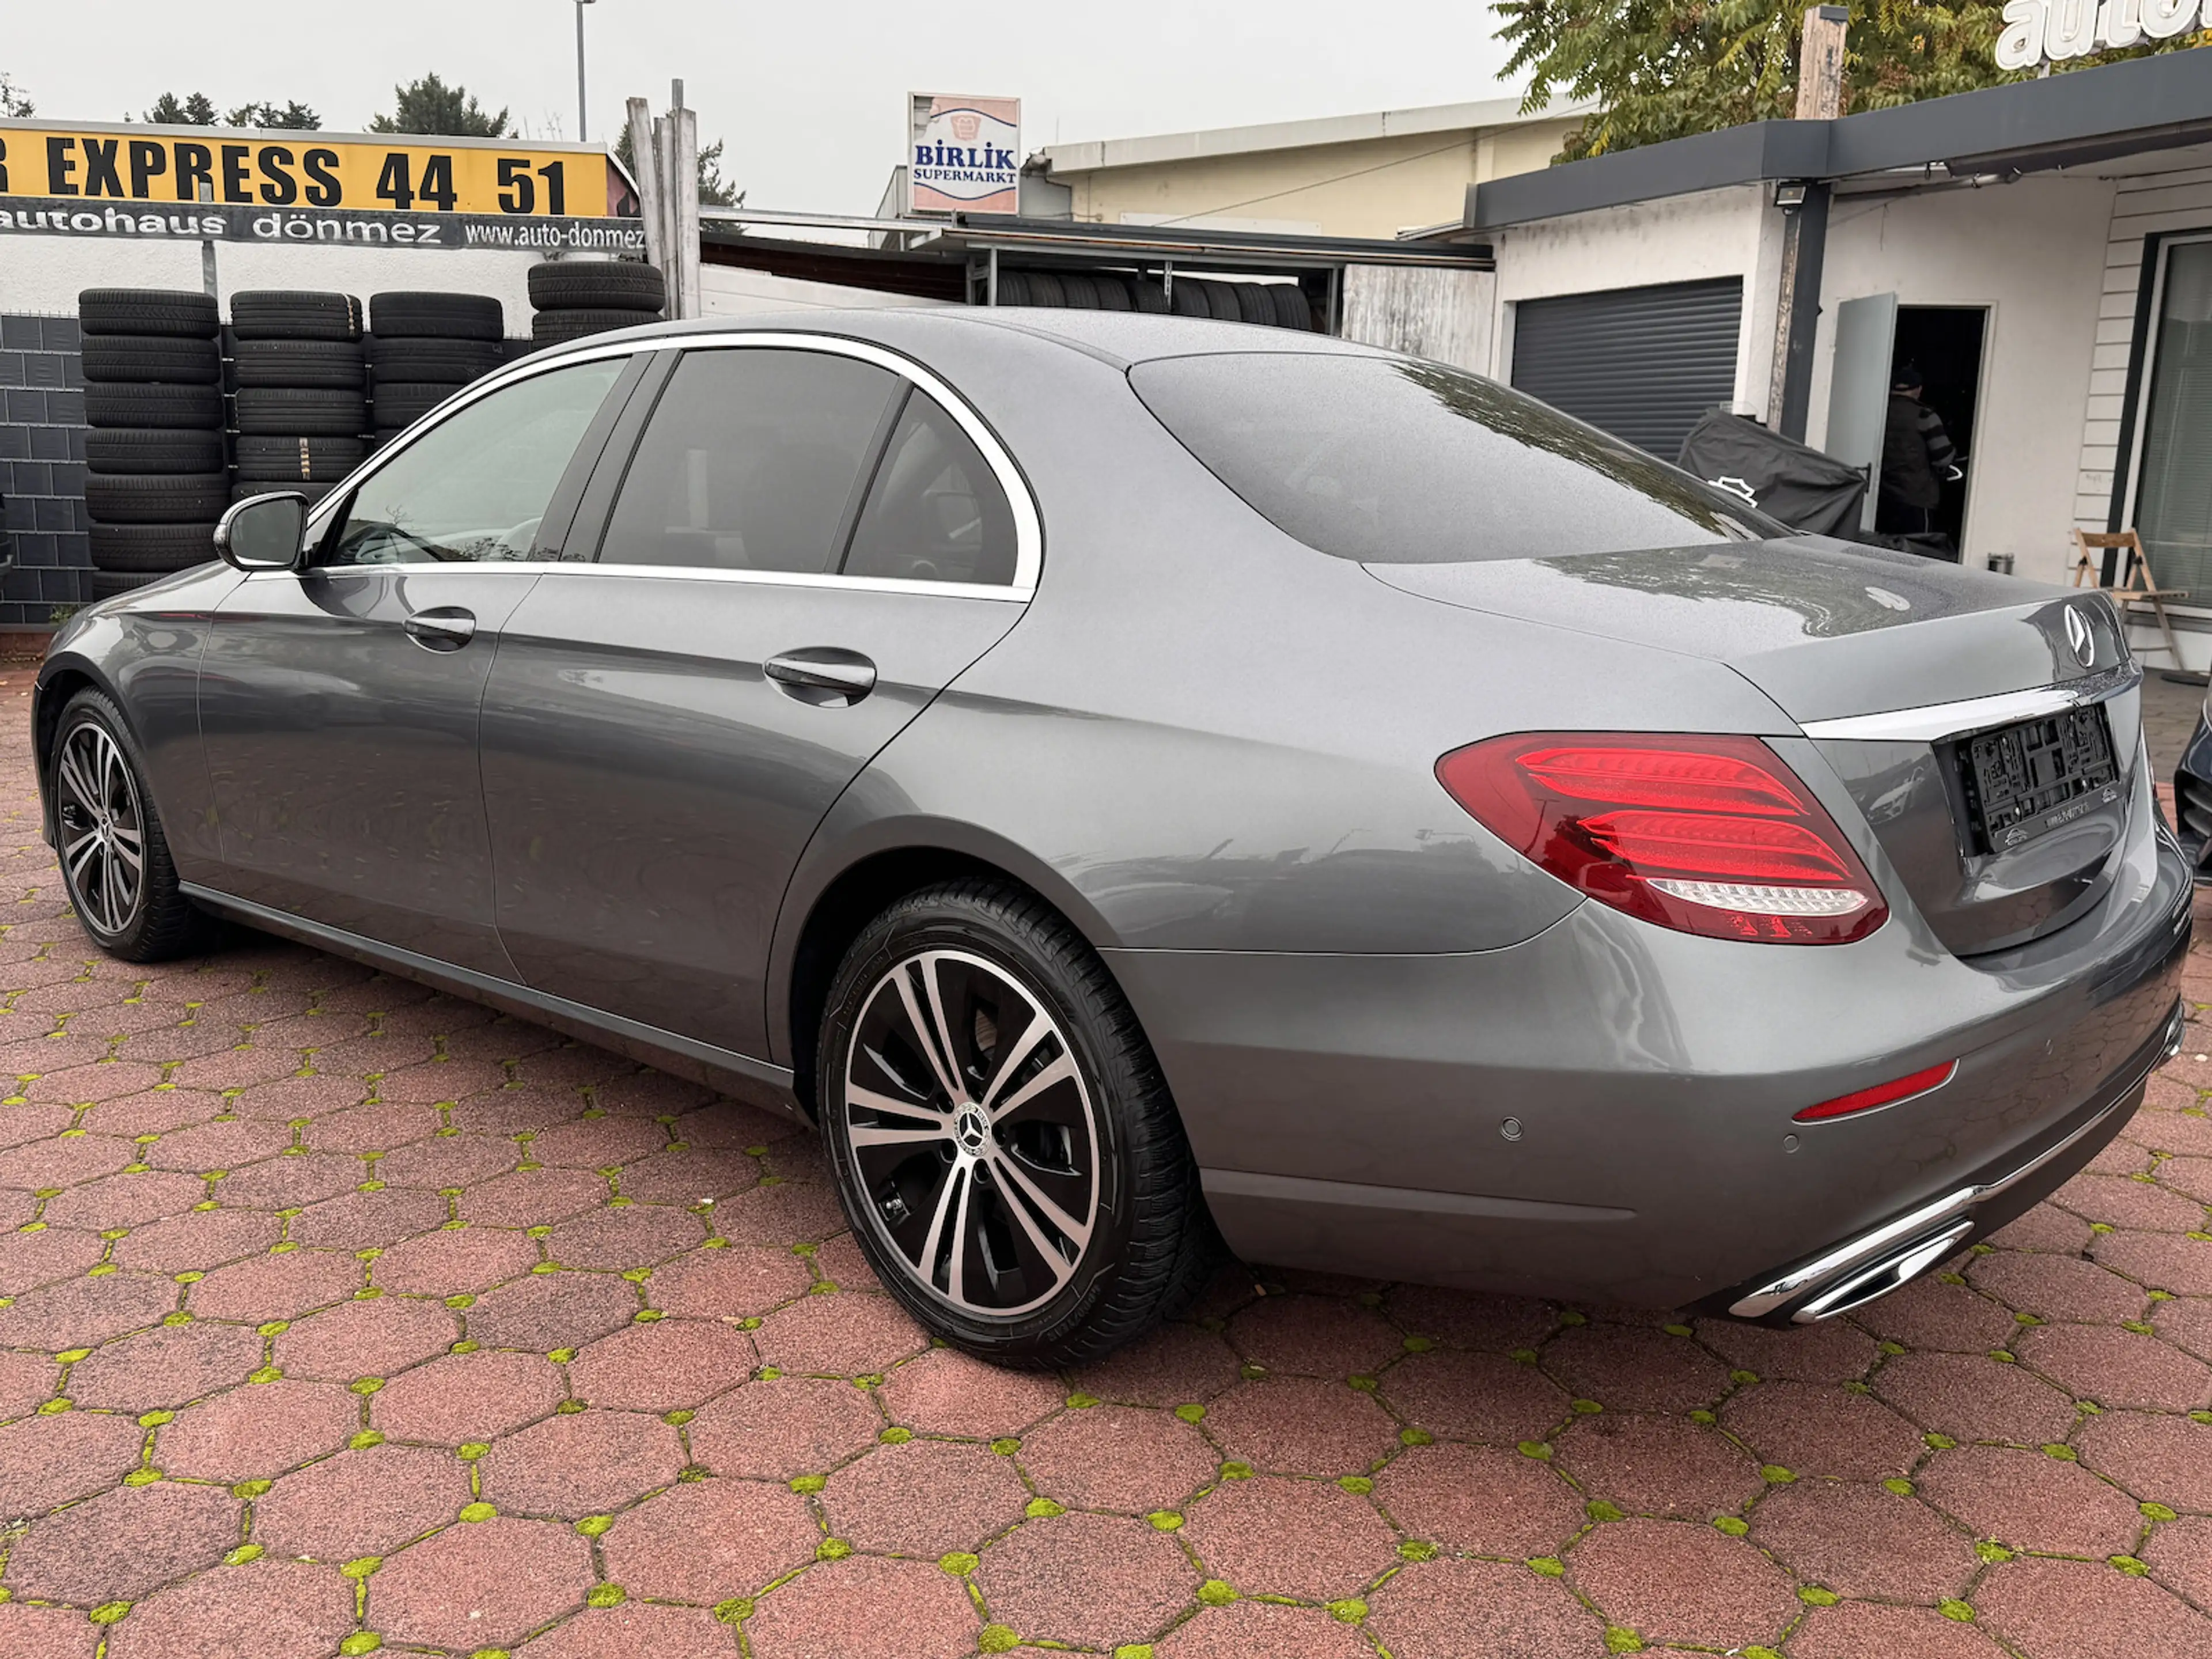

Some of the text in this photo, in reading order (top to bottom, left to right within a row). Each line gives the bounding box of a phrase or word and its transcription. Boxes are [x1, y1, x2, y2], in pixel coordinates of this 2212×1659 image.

[915, 139, 1017, 169] BİRLİK
[47, 136, 342, 207] EXPRESS
[376, 153, 457, 211] 44
[497, 157, 565, 215] 51
[914, 168, 1017, 183] SUPERMARKT
[252, 213, 442, 244] dönmez
